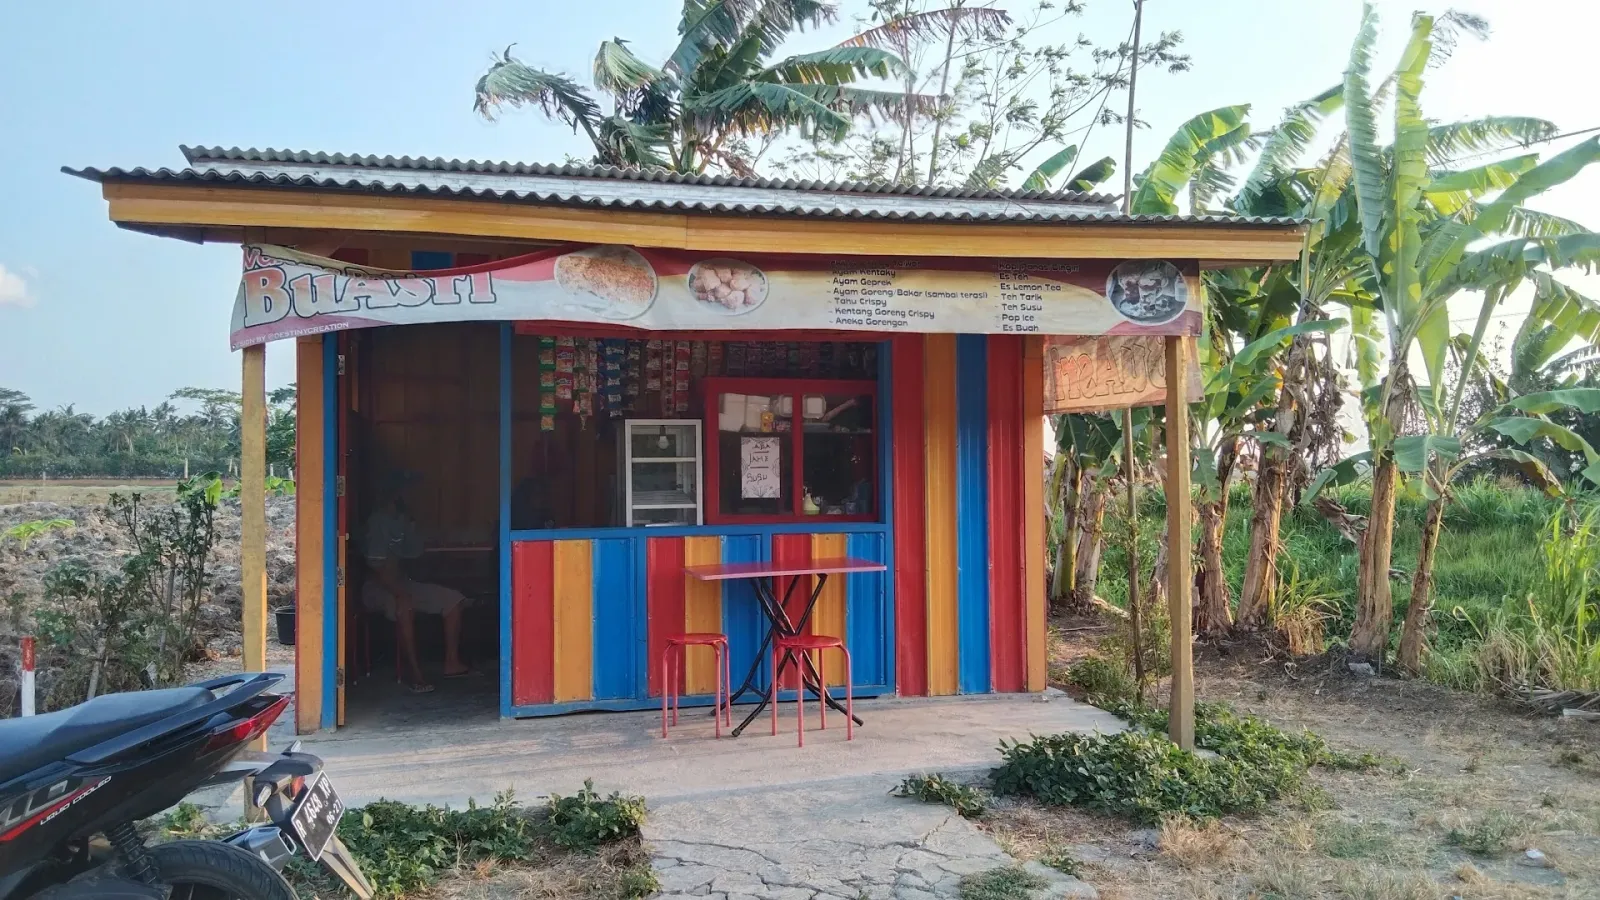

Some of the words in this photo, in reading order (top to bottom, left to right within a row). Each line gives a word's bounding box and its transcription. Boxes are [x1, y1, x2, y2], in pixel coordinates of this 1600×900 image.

[860, 269, 896, 278] Kentaky
[832, 277, 858, 287] Ayam
[860, 278, 892, 287] Geprek
[1000, 282, 1011, 290] Es
[1013, 283, 1043, 291] Lemon
[833, 287, 858, 296] Ayam
[834, 297, 857, 305] Tahu
[859, 298, 887, 307] Crispy
[1020, 293, 1043, 301] Tarik
[1002, 303, 1018, 311] Teh
[1020, 303, 1042, 311] Susu
[835, 307, 873, 317] Kentang
[875, 308, 906, 318] Goreng
[908, 309, 935, 319] Crispy
[1002, 313, 1020, 323] Pop
[836, 317, 863, 325] Aneka
[866, 318, 908, 328] Gorengan
[1016, 324, 1039, 332] Buah
[40, 803, 71, 826] LIQUID
[73, 776, 112, 804] COOLED
[295, 819, 307, 838] R
[318, 777, 331, 799] XP
